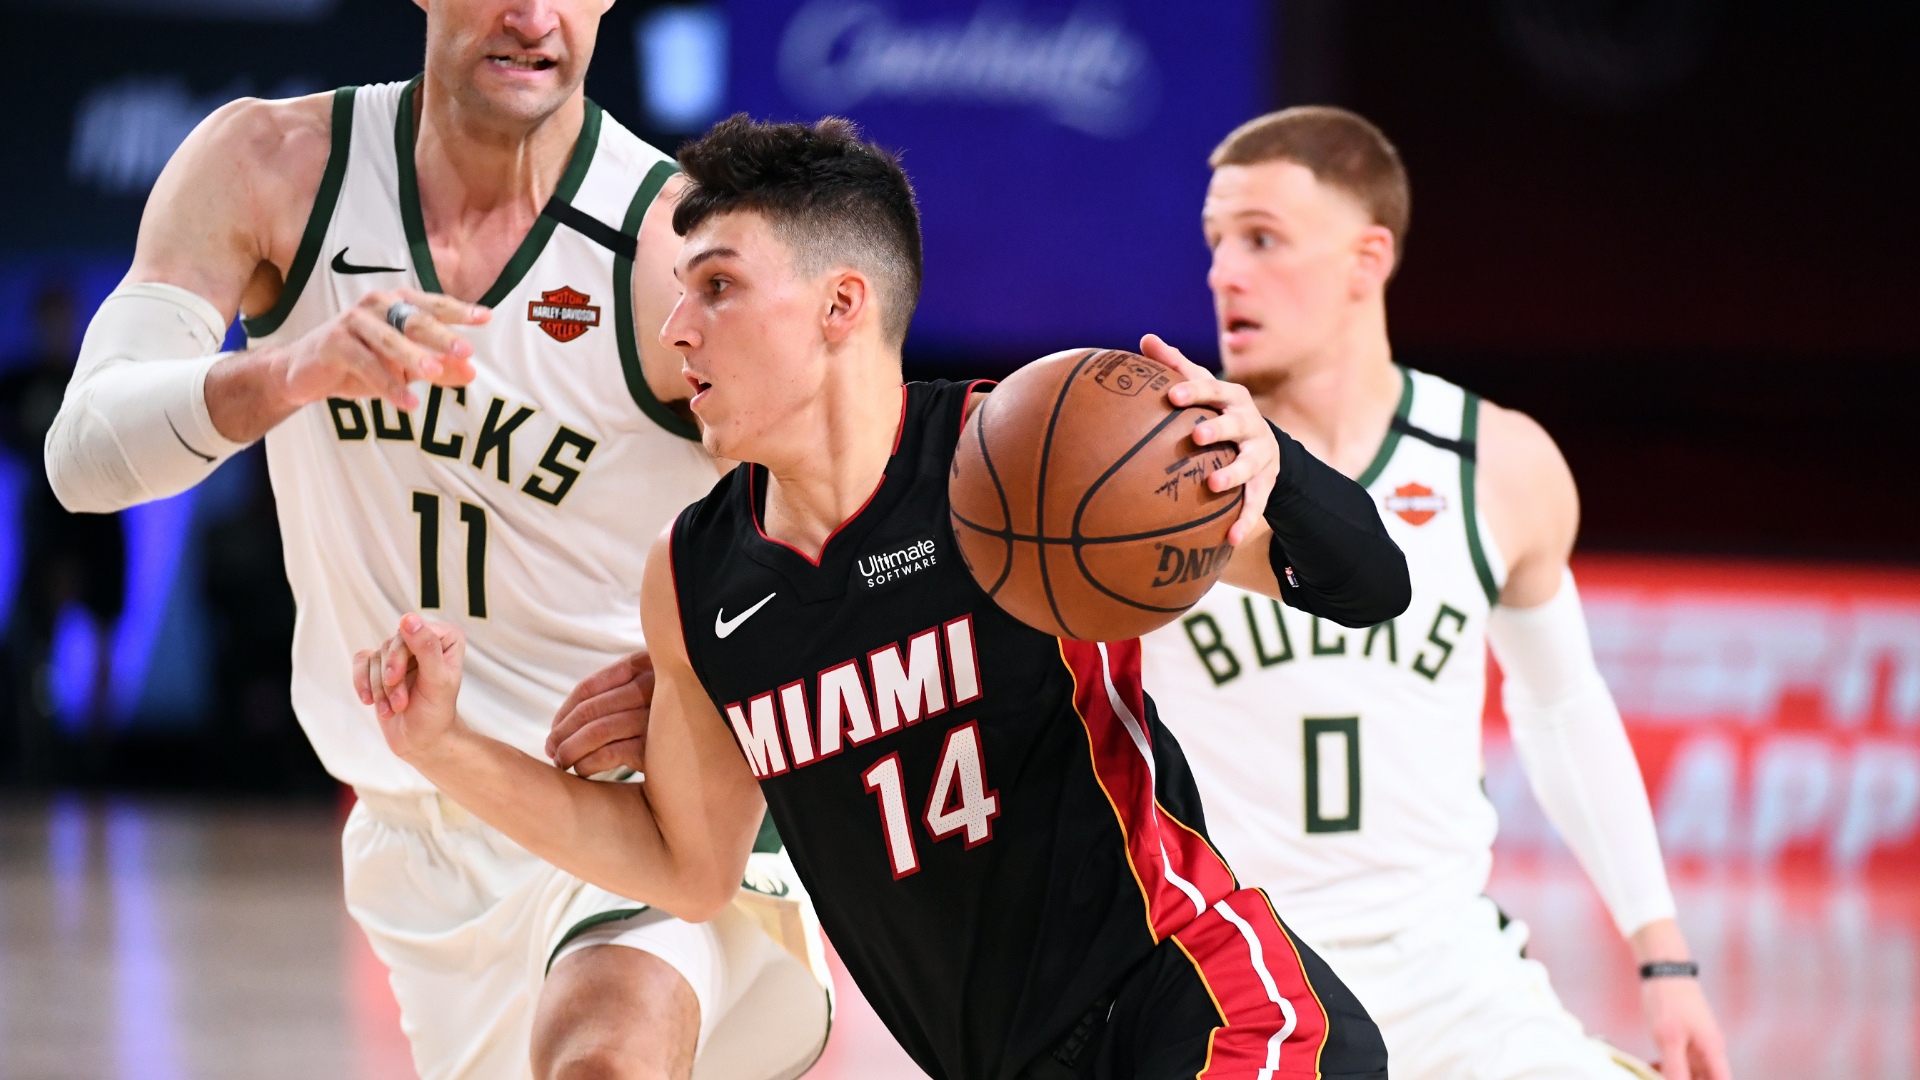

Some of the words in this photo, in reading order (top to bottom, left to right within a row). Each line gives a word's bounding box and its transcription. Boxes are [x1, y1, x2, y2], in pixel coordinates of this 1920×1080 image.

[326, 382, 599, 507] BUCKS
[411, 489, 489, 620] 11
[857, 539, 936, 577] Ultimate
[867, 555, 937, 588] SOFTWARE
[723, 612, 984, 781] MIAMI
[860, 718, 1001, 881] 14
[1302, 714, 1362, 834] 0
